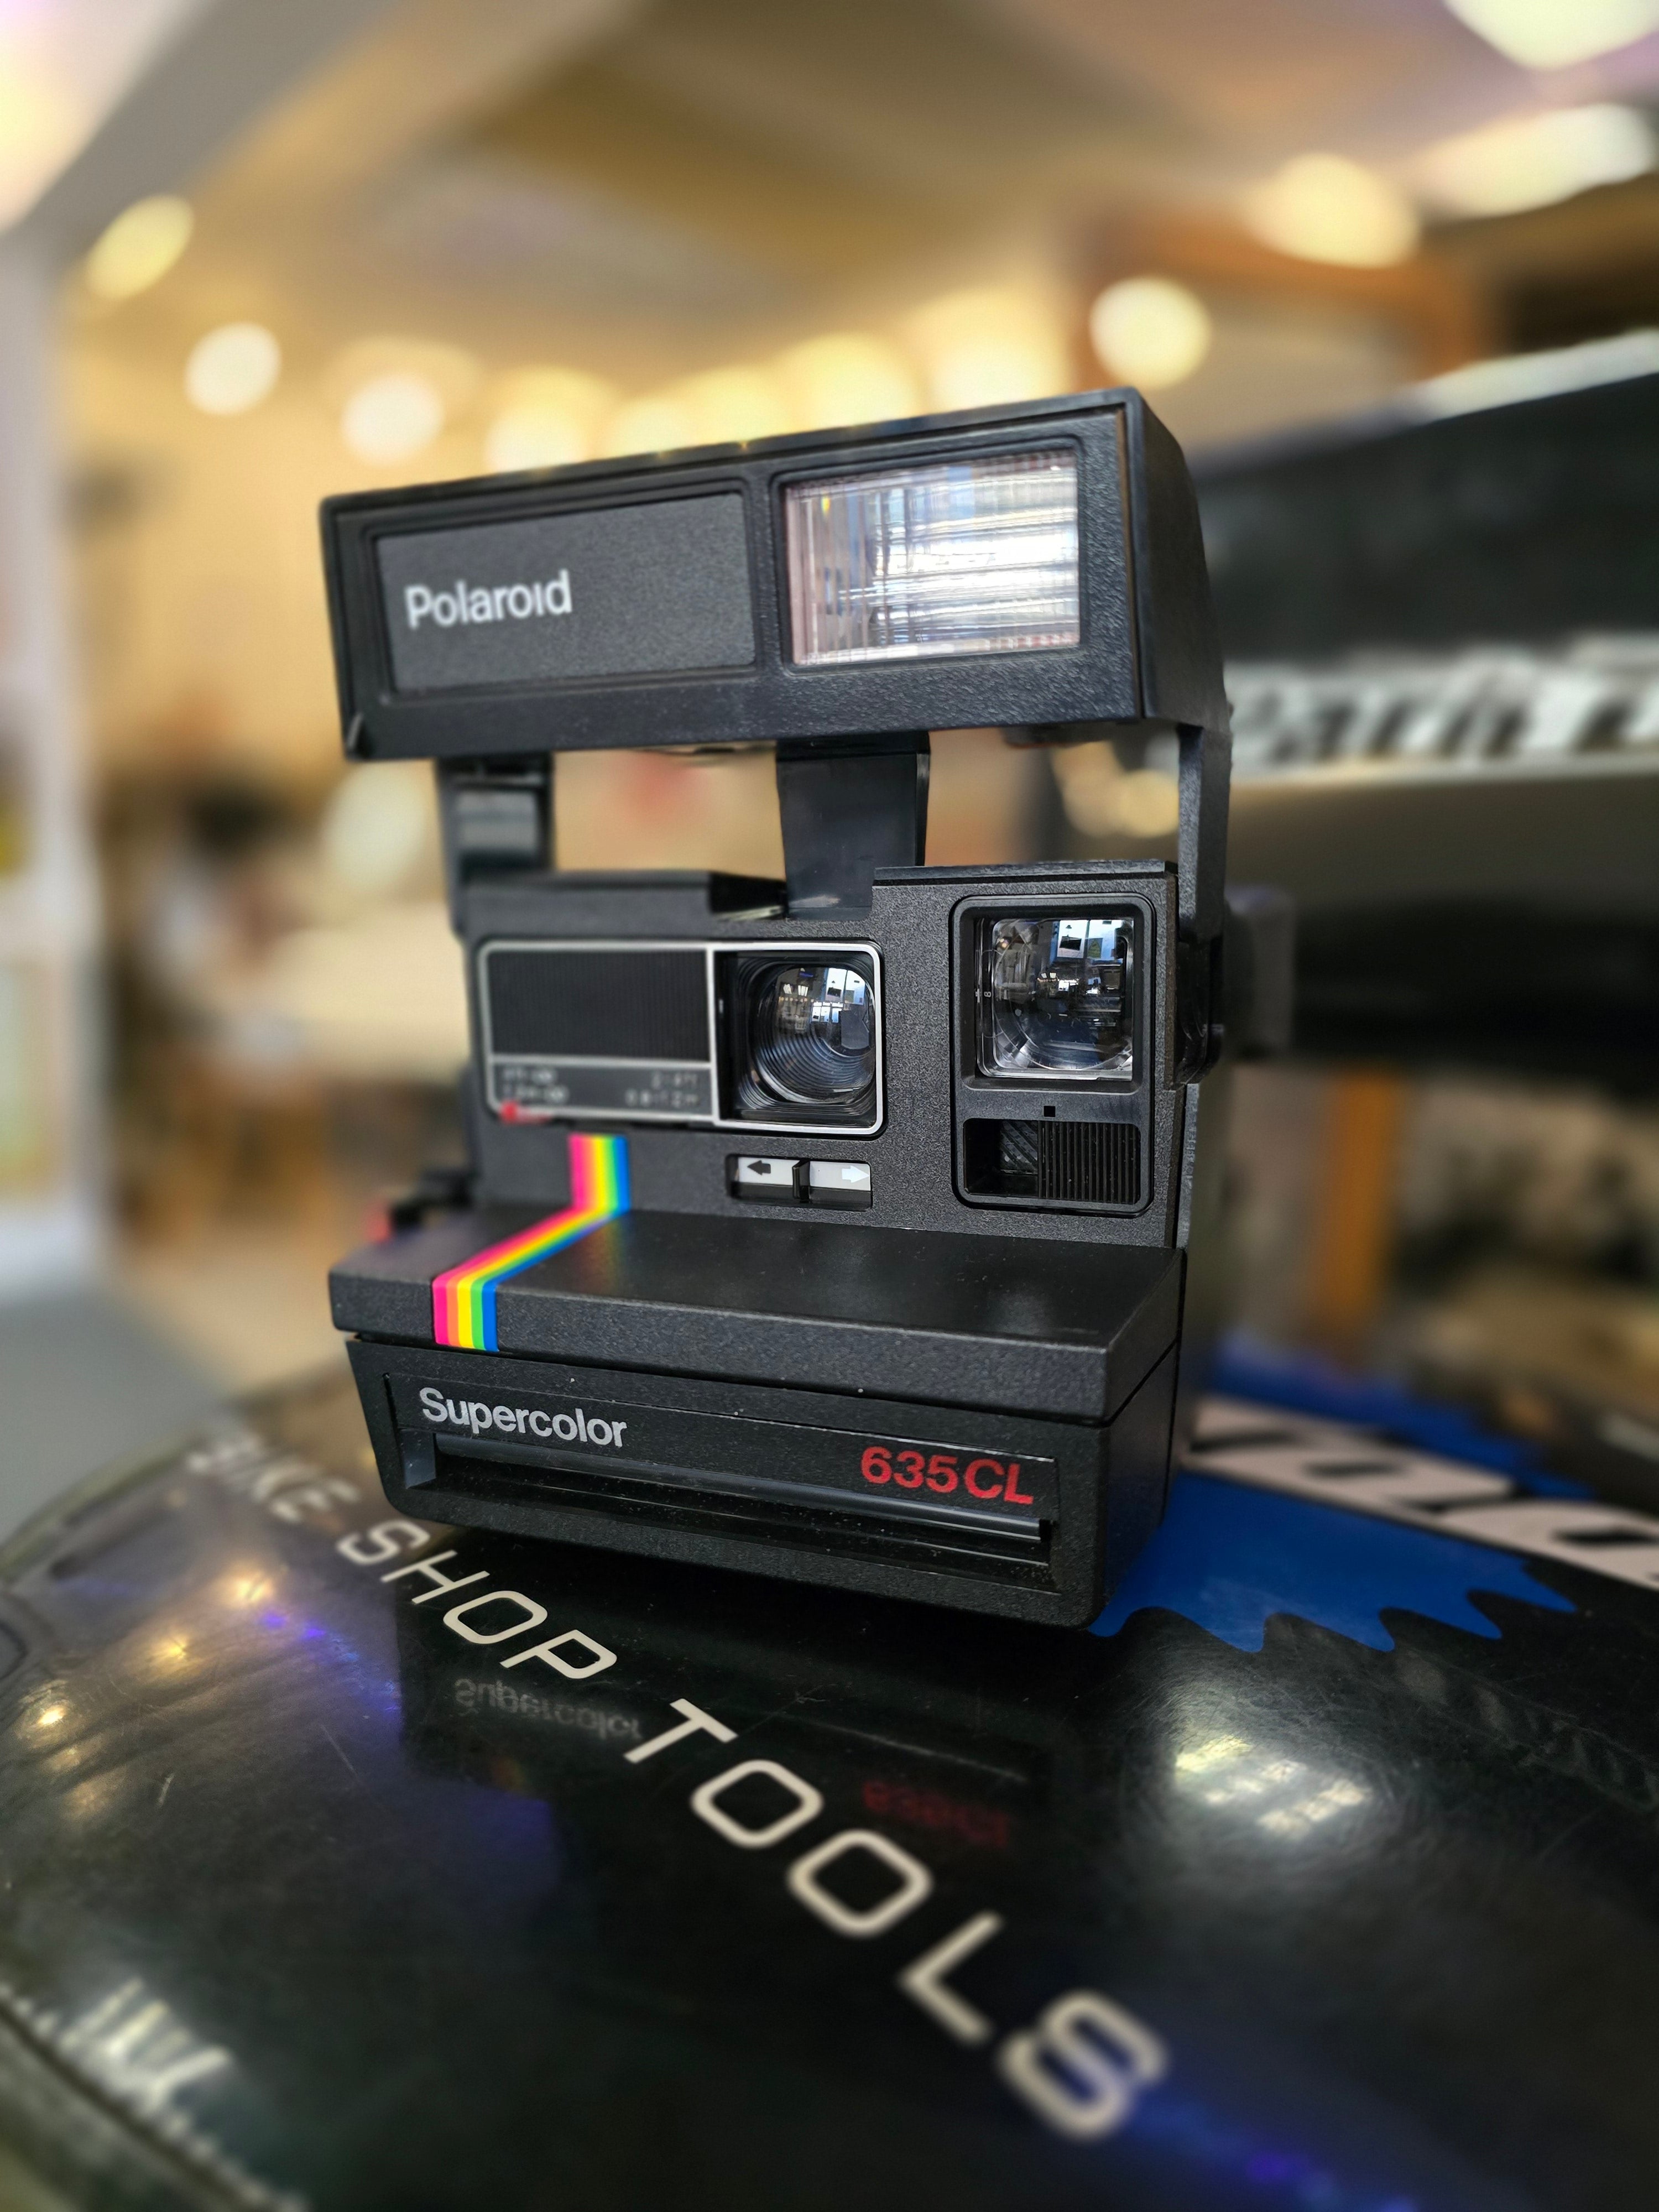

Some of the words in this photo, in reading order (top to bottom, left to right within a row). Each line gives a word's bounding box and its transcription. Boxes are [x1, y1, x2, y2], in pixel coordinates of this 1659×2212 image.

[404, 568, 573, 630] Polaroid
[419, 1386, 627, 1447] Supercolor
[860, 1446, 1035, 1505] 635CL
[336, 1519, 618, 1679] SHOP
[622, 1698, 1168, 2139] TOOLS
